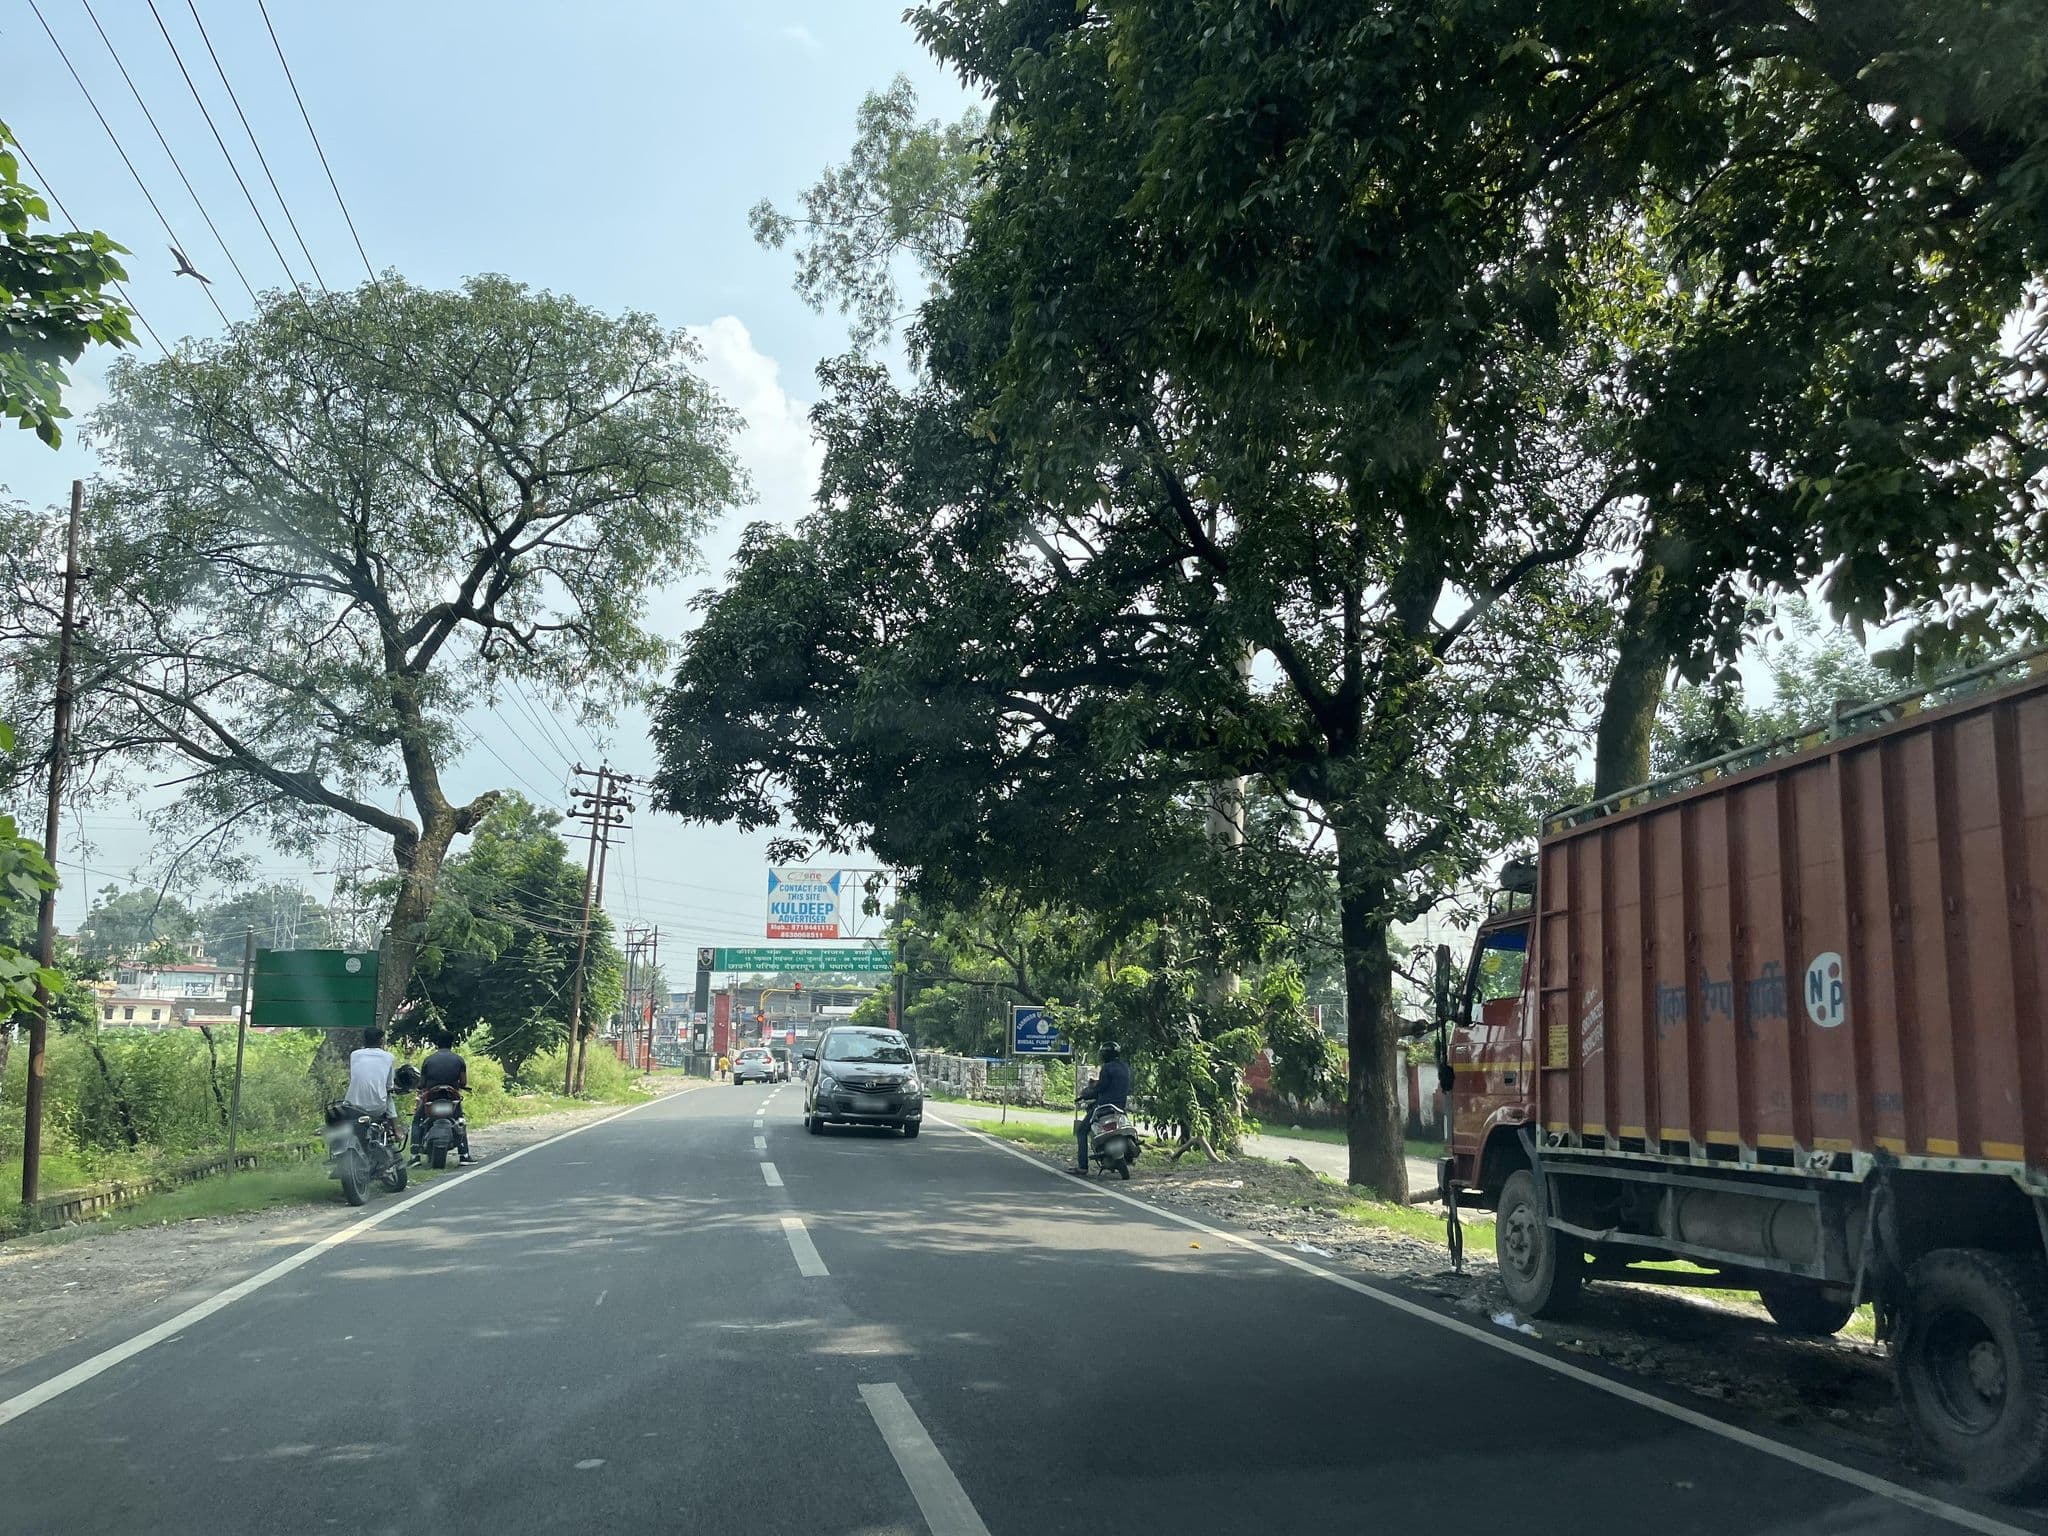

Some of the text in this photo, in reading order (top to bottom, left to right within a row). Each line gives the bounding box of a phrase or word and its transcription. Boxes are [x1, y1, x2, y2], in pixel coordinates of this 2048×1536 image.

[779, 884, 828, 893] CONTACT FOR
[788, 893, 821, 901] THIS SITE
[771, 902, 834, 915] KULDEEP
[778, 914, 826, 923] ADVERTISER
